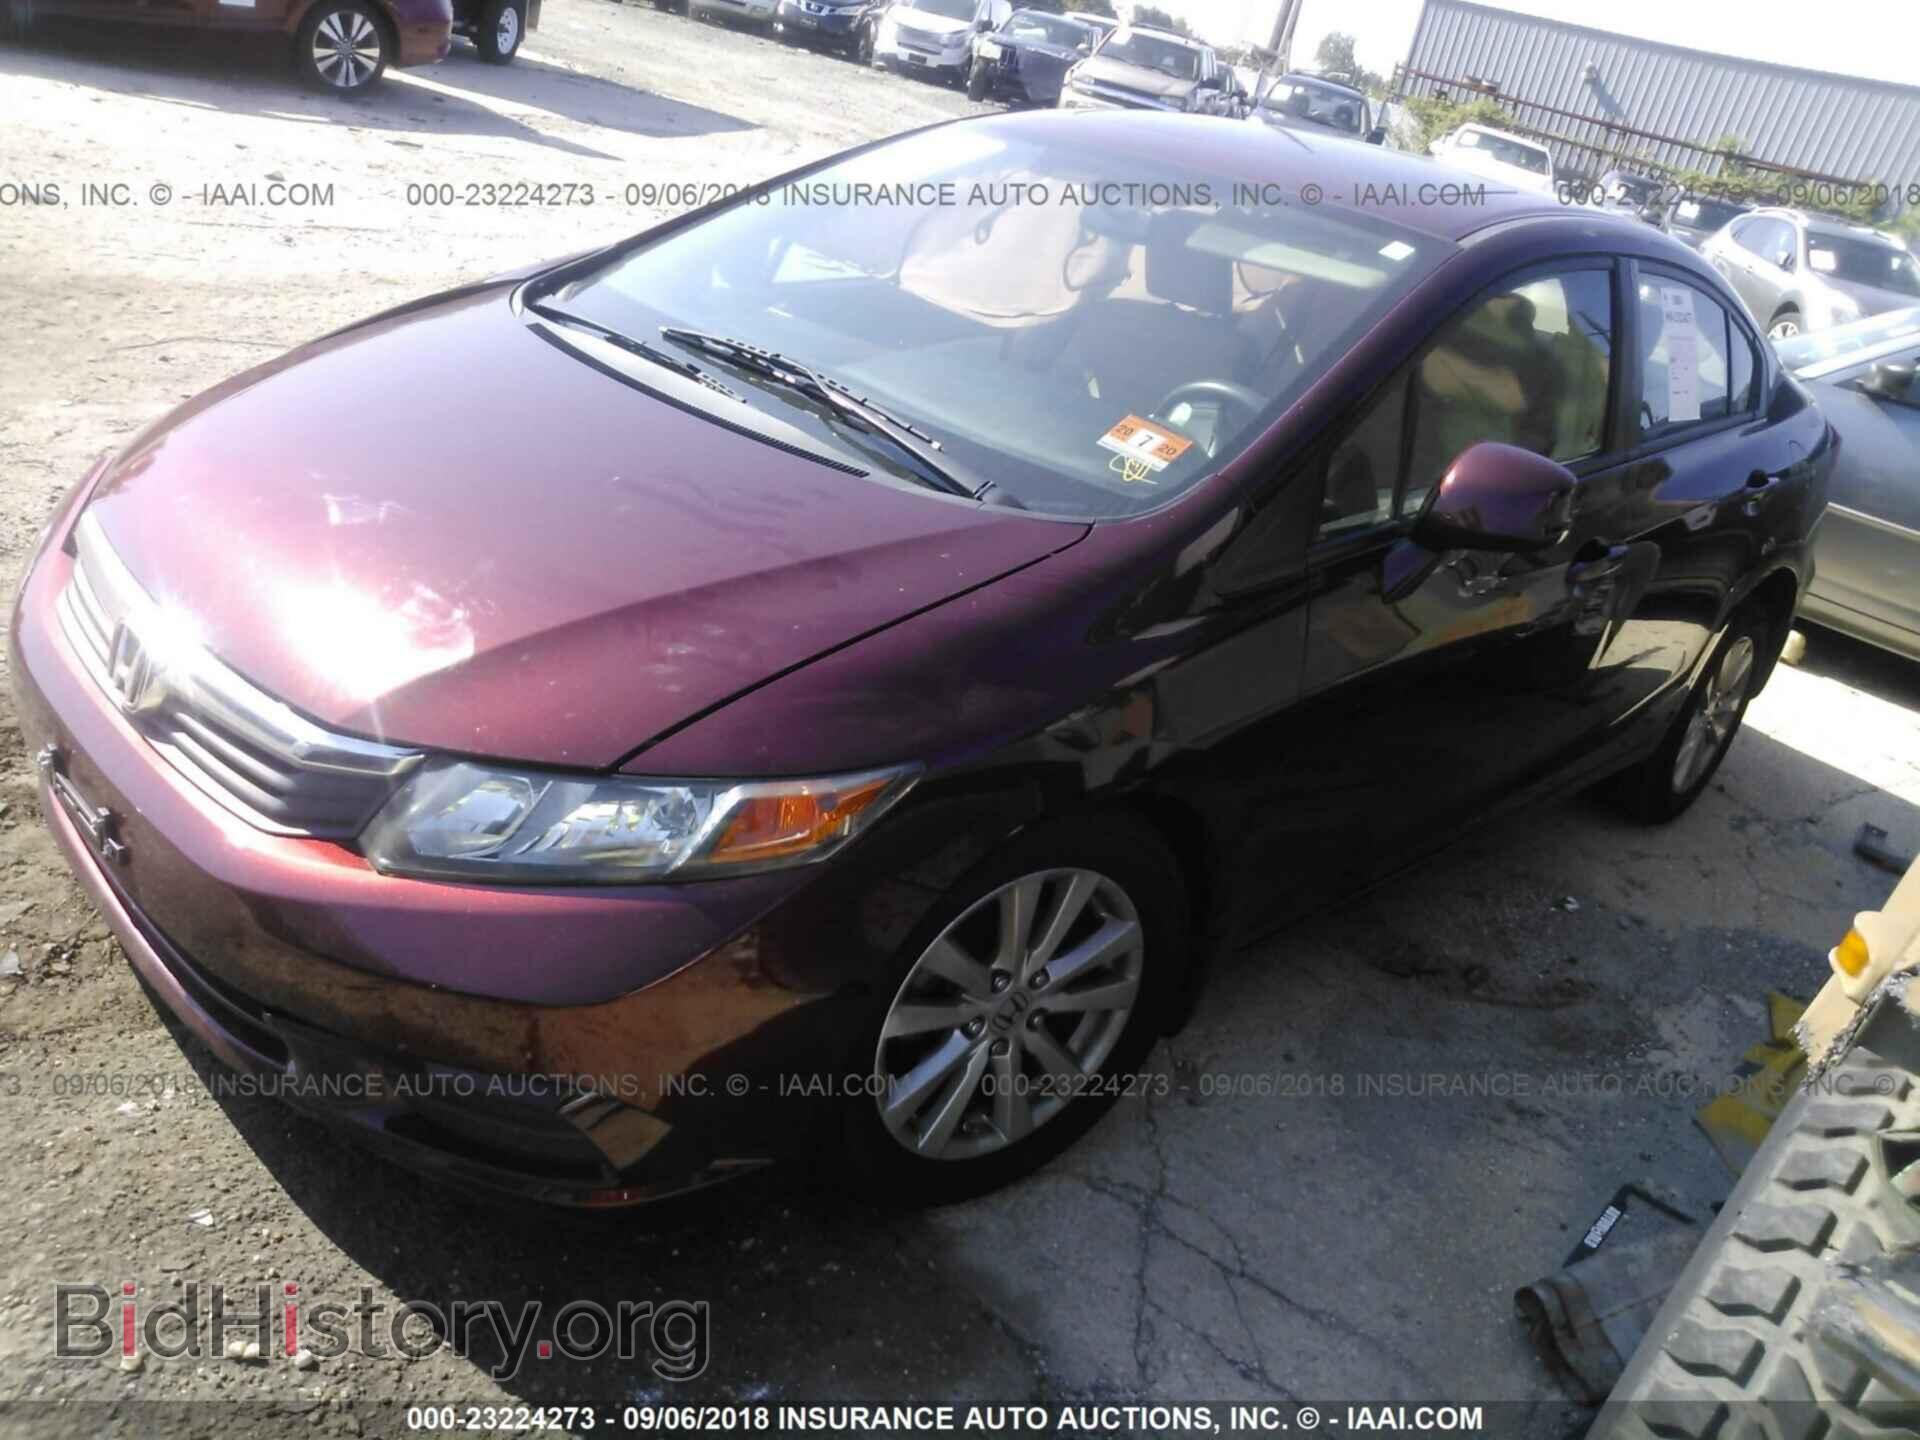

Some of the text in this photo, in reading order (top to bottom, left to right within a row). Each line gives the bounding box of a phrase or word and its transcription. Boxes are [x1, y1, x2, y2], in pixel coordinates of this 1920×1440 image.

[1115, 424, 1177, 455] 20 7 20
